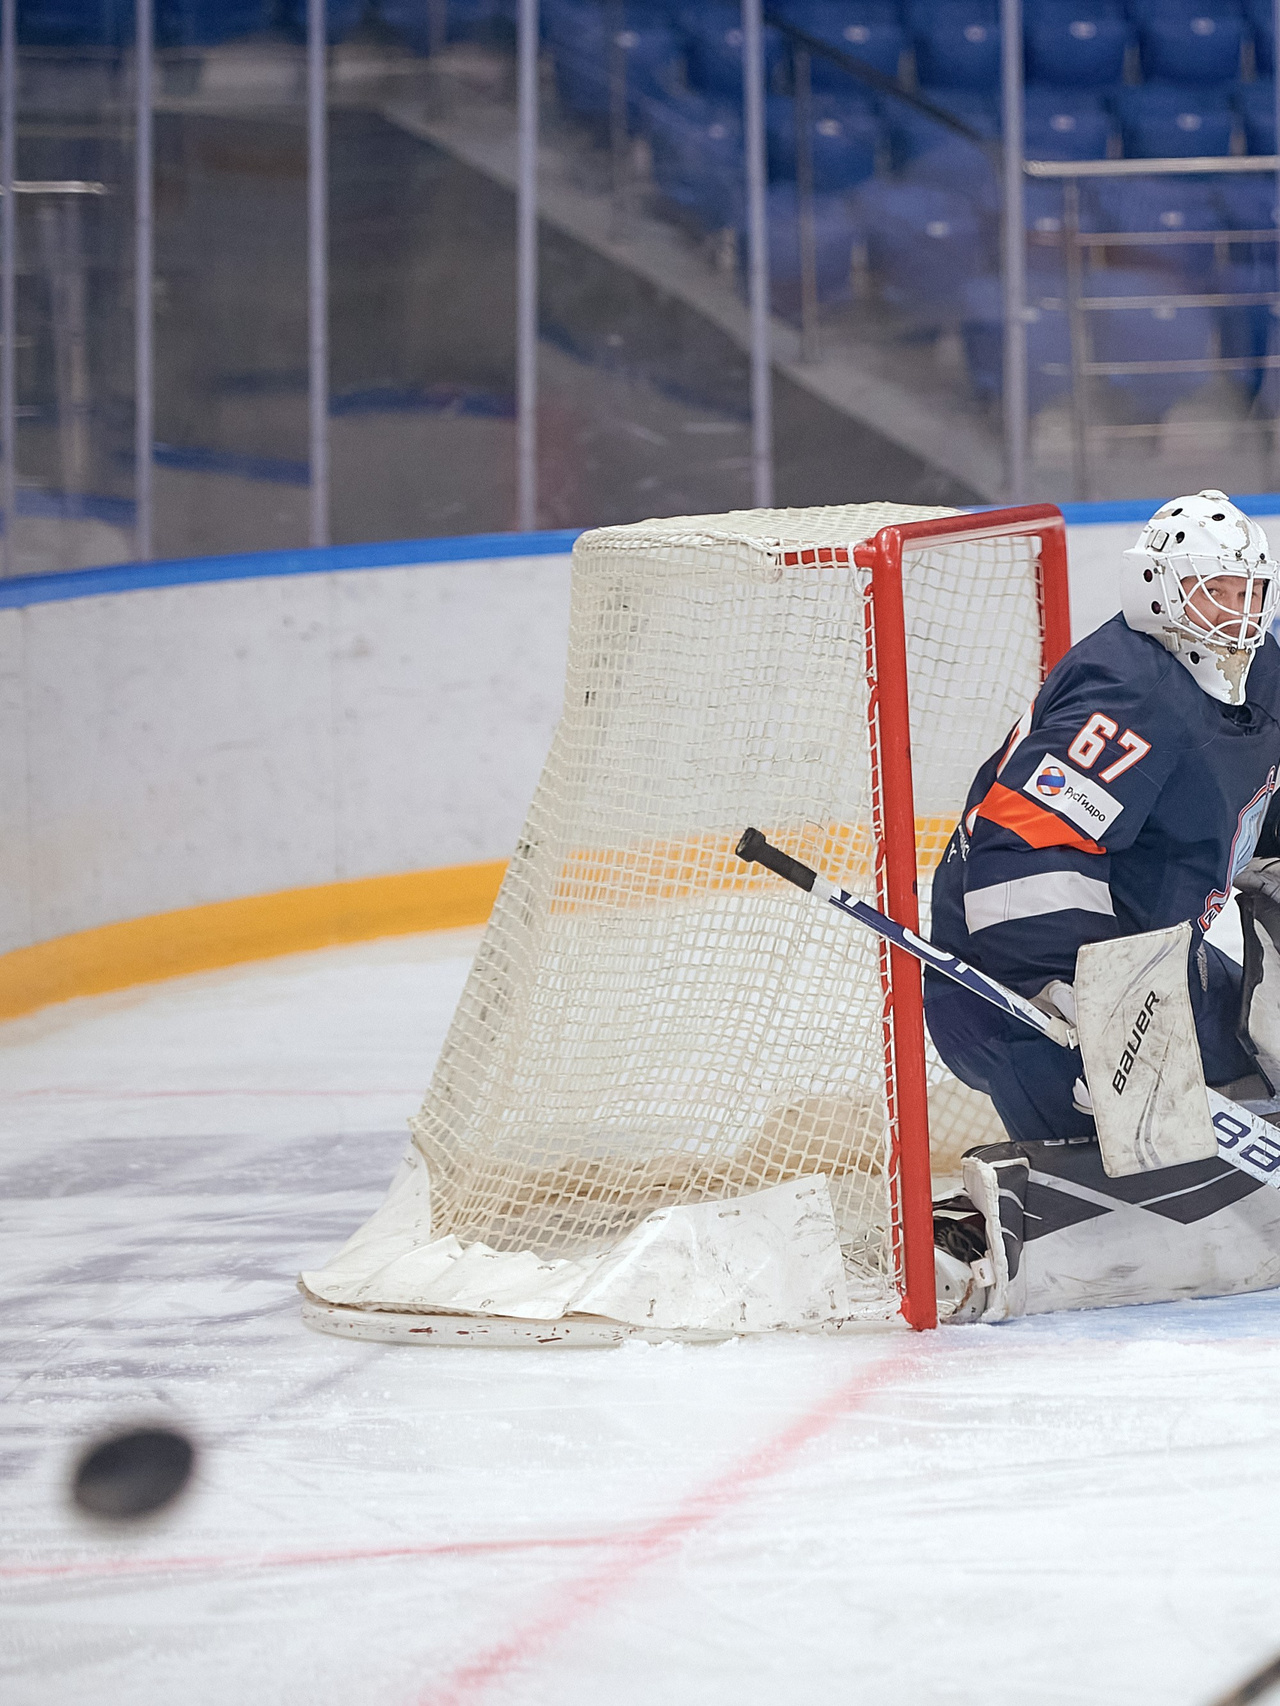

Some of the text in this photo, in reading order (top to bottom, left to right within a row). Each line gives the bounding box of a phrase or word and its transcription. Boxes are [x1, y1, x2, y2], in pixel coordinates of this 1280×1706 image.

[1067, 711, 1152, 784] 67
[1064, 786, 1107, 822] РусГидро
[1112, 990, 1160, 1095] BAUER
